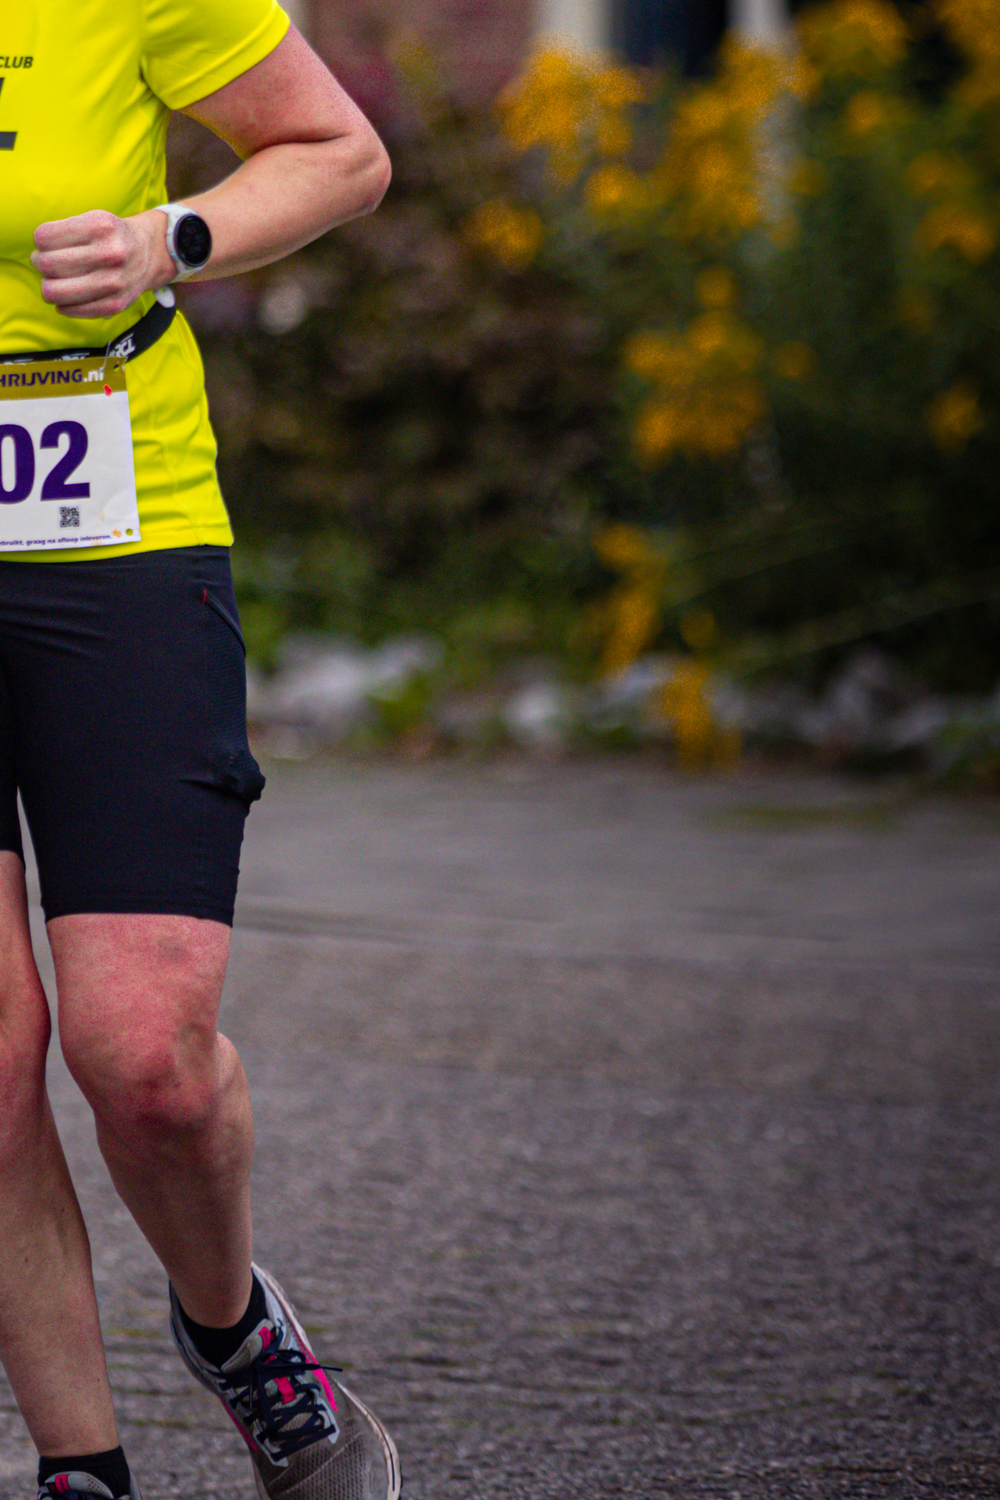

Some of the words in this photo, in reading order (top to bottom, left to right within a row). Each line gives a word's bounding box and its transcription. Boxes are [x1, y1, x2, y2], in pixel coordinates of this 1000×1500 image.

[25, 539, 46, 547] graag
[57, 536, 79, 544] afloop
[80, 534, 112, 542] inleveren.
